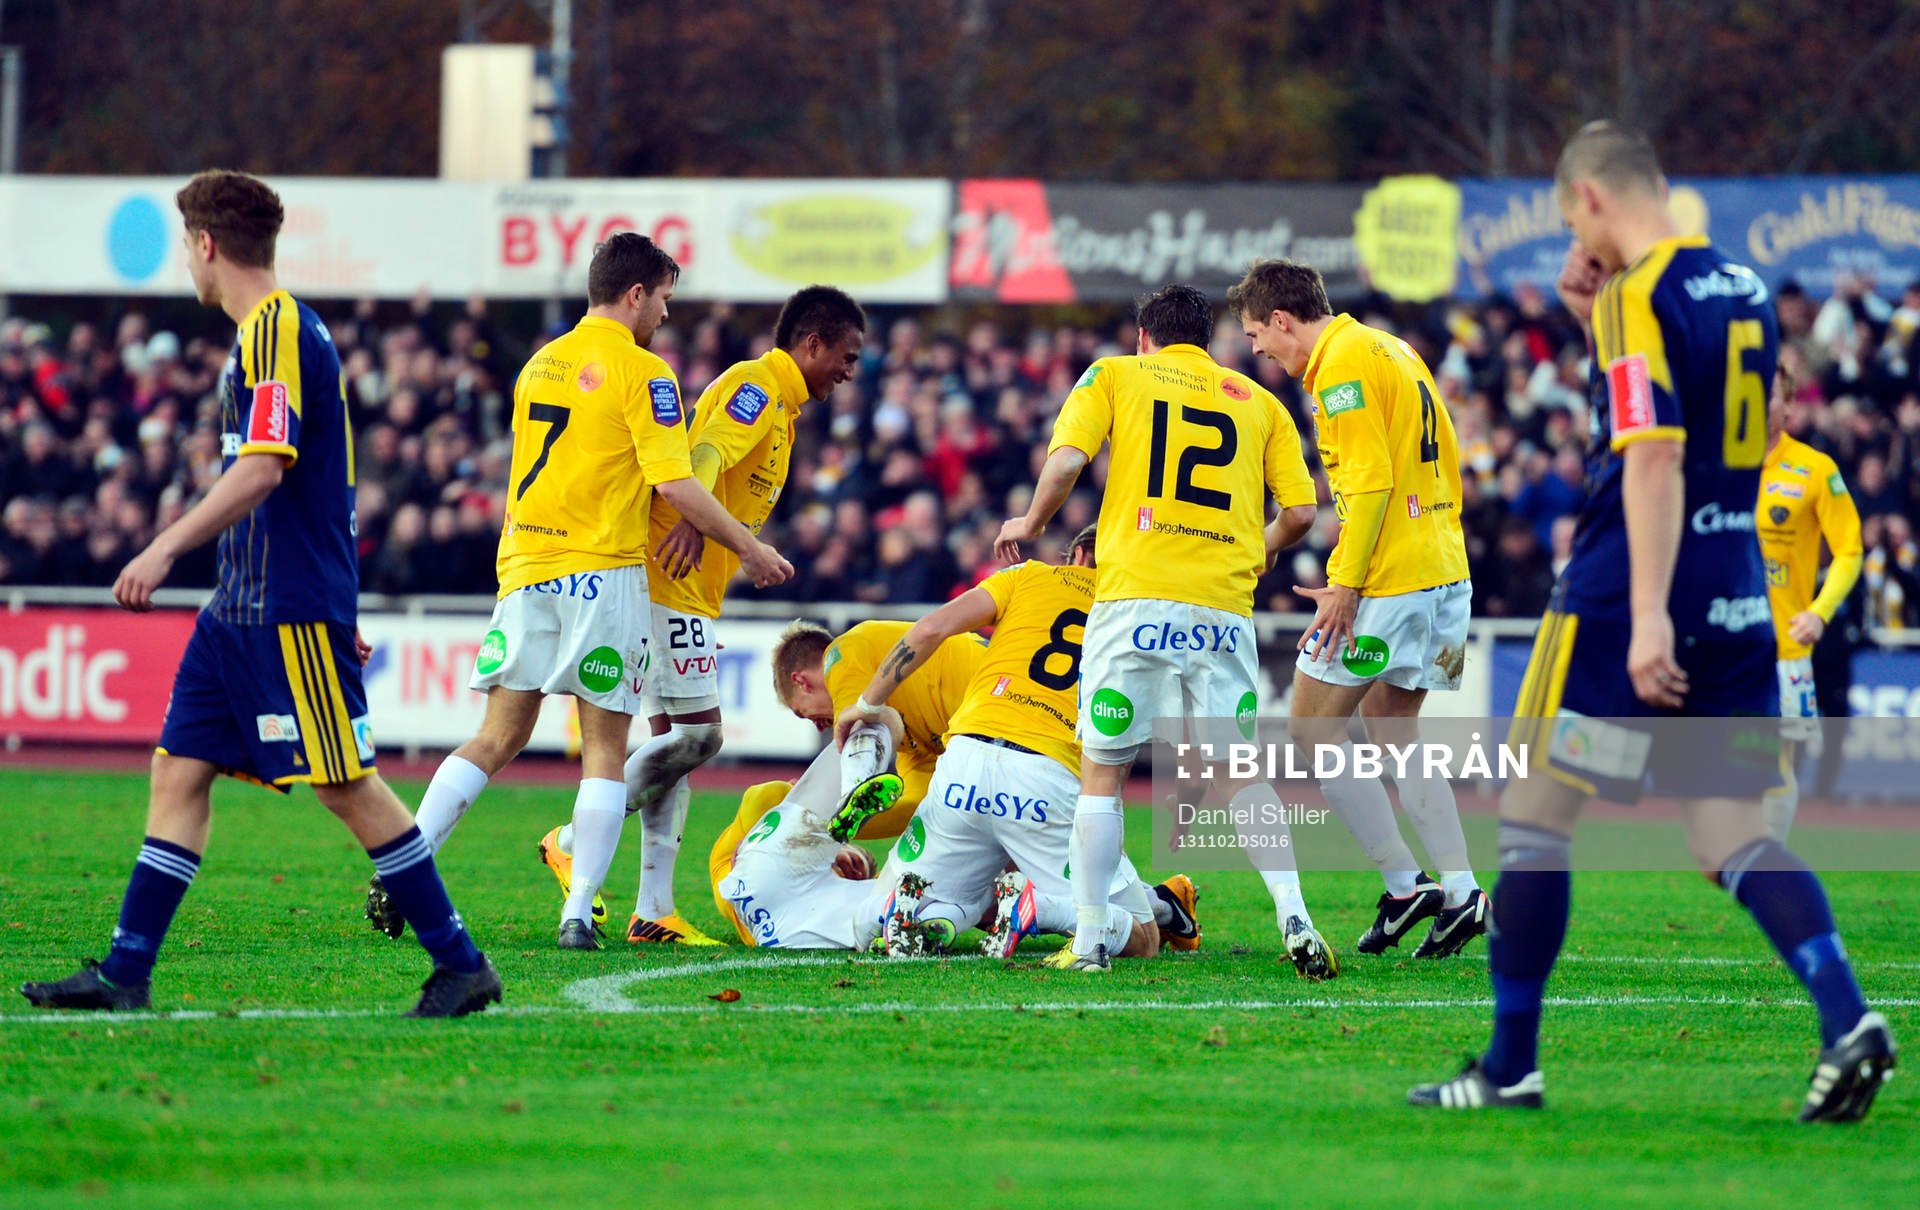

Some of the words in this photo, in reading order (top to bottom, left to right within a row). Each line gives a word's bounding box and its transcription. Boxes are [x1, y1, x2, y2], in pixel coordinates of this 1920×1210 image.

[529, 368, 565, 382] parbank
[1139, 361, 1208, 383] Falkenbergs
[1153, 372, 1207, 392] Sparbank
[1723, 319, 1768, 468] 6
[267, 385, 285, 441] Adecco
[1417, 380, 1439, 478] 4
[516, 402, 571, 502] 7
[1147, 399, 1238, 511] 12
[1153, 520, 1235, 544] bygghemma.se
[668, 618, 705, 649] 28
[1132, 623, 1240, 653] GleSYS
[479, 642, 504, 661] dina
[1028, 608, 1089, 691] 8
[1346, 646, 1385, 662] dina
[583, 659, 619, 677] dina
[1004, 689, 1076, 731] bygghemma.se
[1094, 701, 1129, 718] dina
[944, 783, 1049, 823] GleSYS
[732, 879, 780, 948] leSYS
